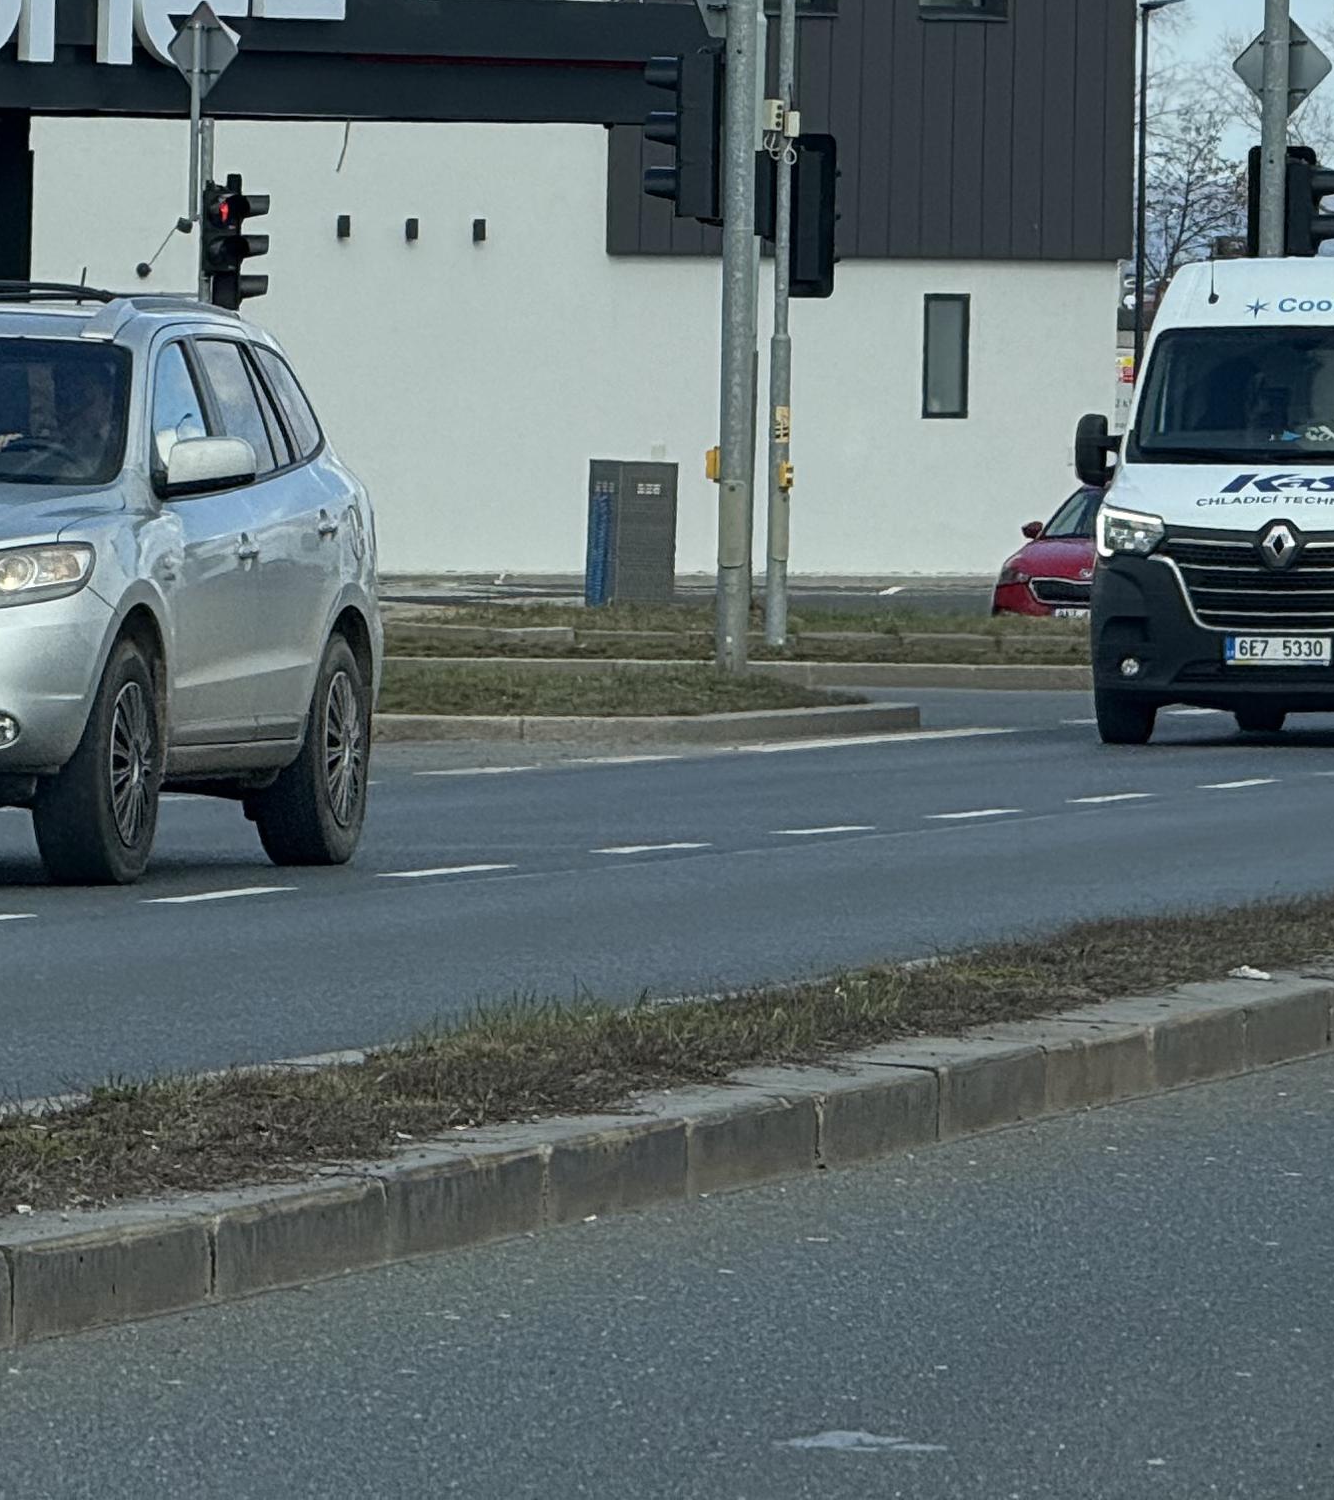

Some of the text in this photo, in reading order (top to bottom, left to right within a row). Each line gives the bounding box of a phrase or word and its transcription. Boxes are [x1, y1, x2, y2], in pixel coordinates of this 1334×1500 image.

[1196, 494, 1278, 507] CHLADICÍ
[1238, 639, 1269, 657] 6E7
[1282, 639, 1323, 657] 5330
